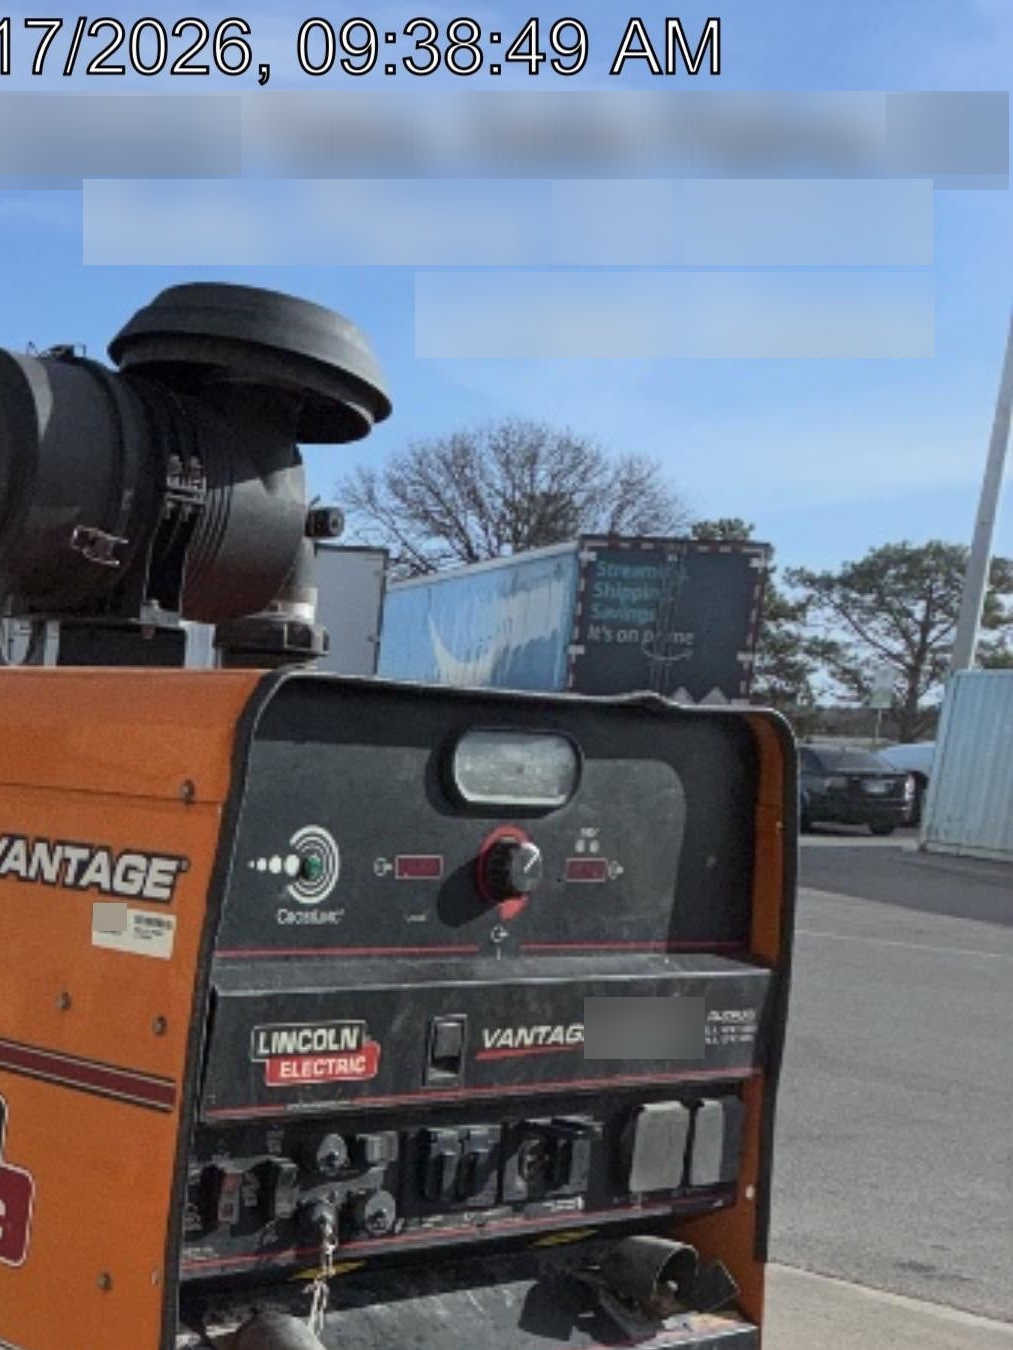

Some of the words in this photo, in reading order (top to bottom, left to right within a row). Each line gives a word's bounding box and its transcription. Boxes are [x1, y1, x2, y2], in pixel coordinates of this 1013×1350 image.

[617, 629, 639, 643] on
[258, 1026, 359, 1055] LINCOLN
[482, 1023, 584, 1048] VANTAG
[281, 1056, 365, 1079] ELECTRIC
